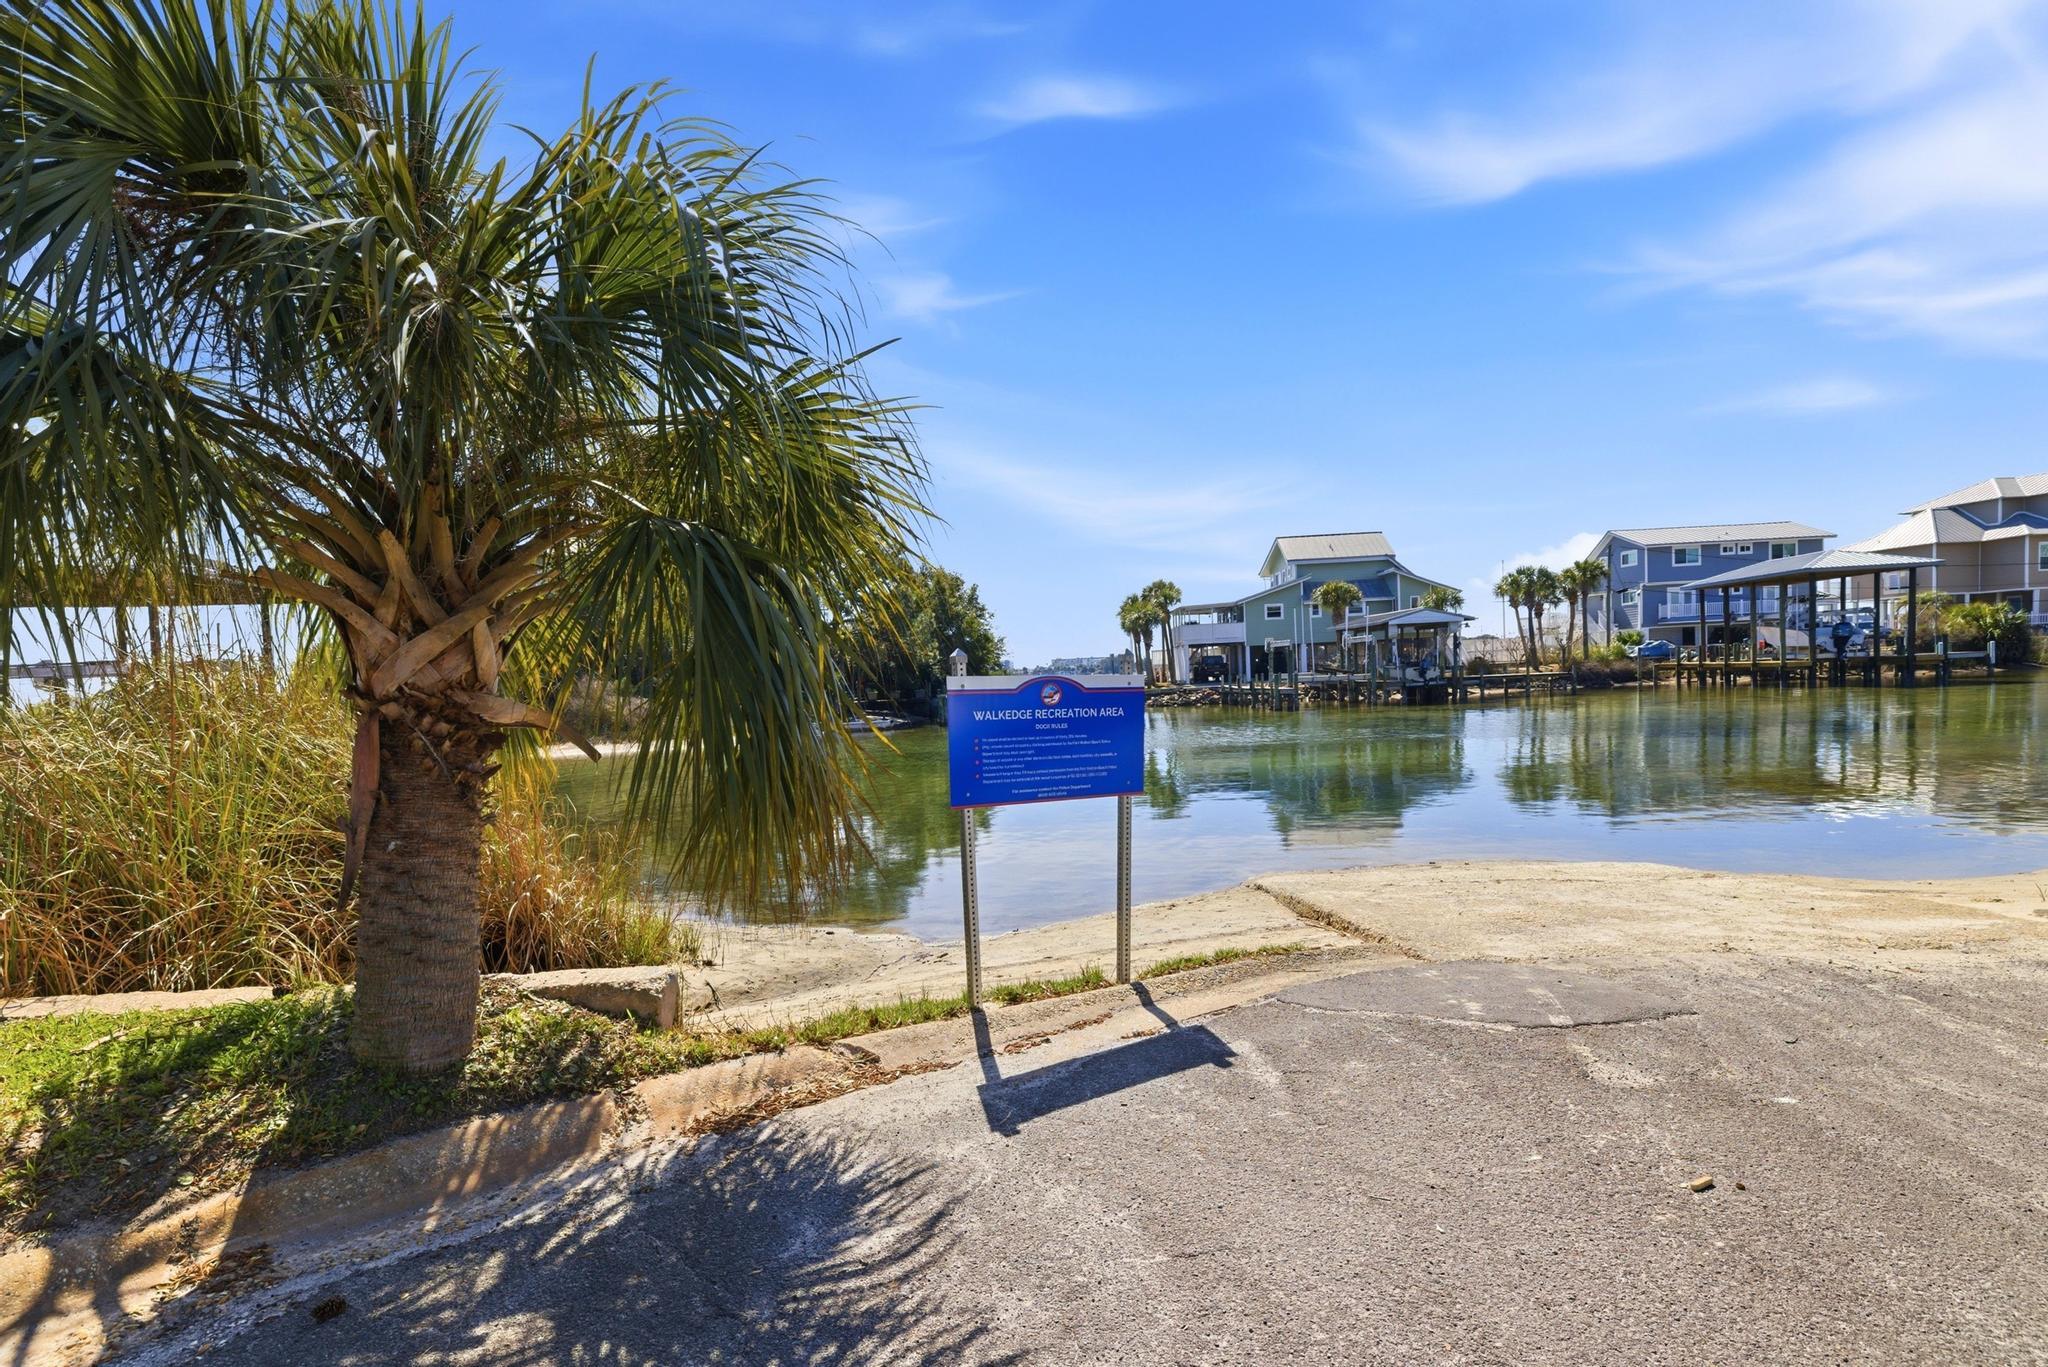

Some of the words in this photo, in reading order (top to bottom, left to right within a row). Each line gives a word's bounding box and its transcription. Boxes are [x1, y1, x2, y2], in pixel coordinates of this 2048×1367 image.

[973, 709, 1033, 721] WALKEDGE
[1035, 708, 1098, 719] RECREATION
[1099, 707, 1125, 717] AREA
